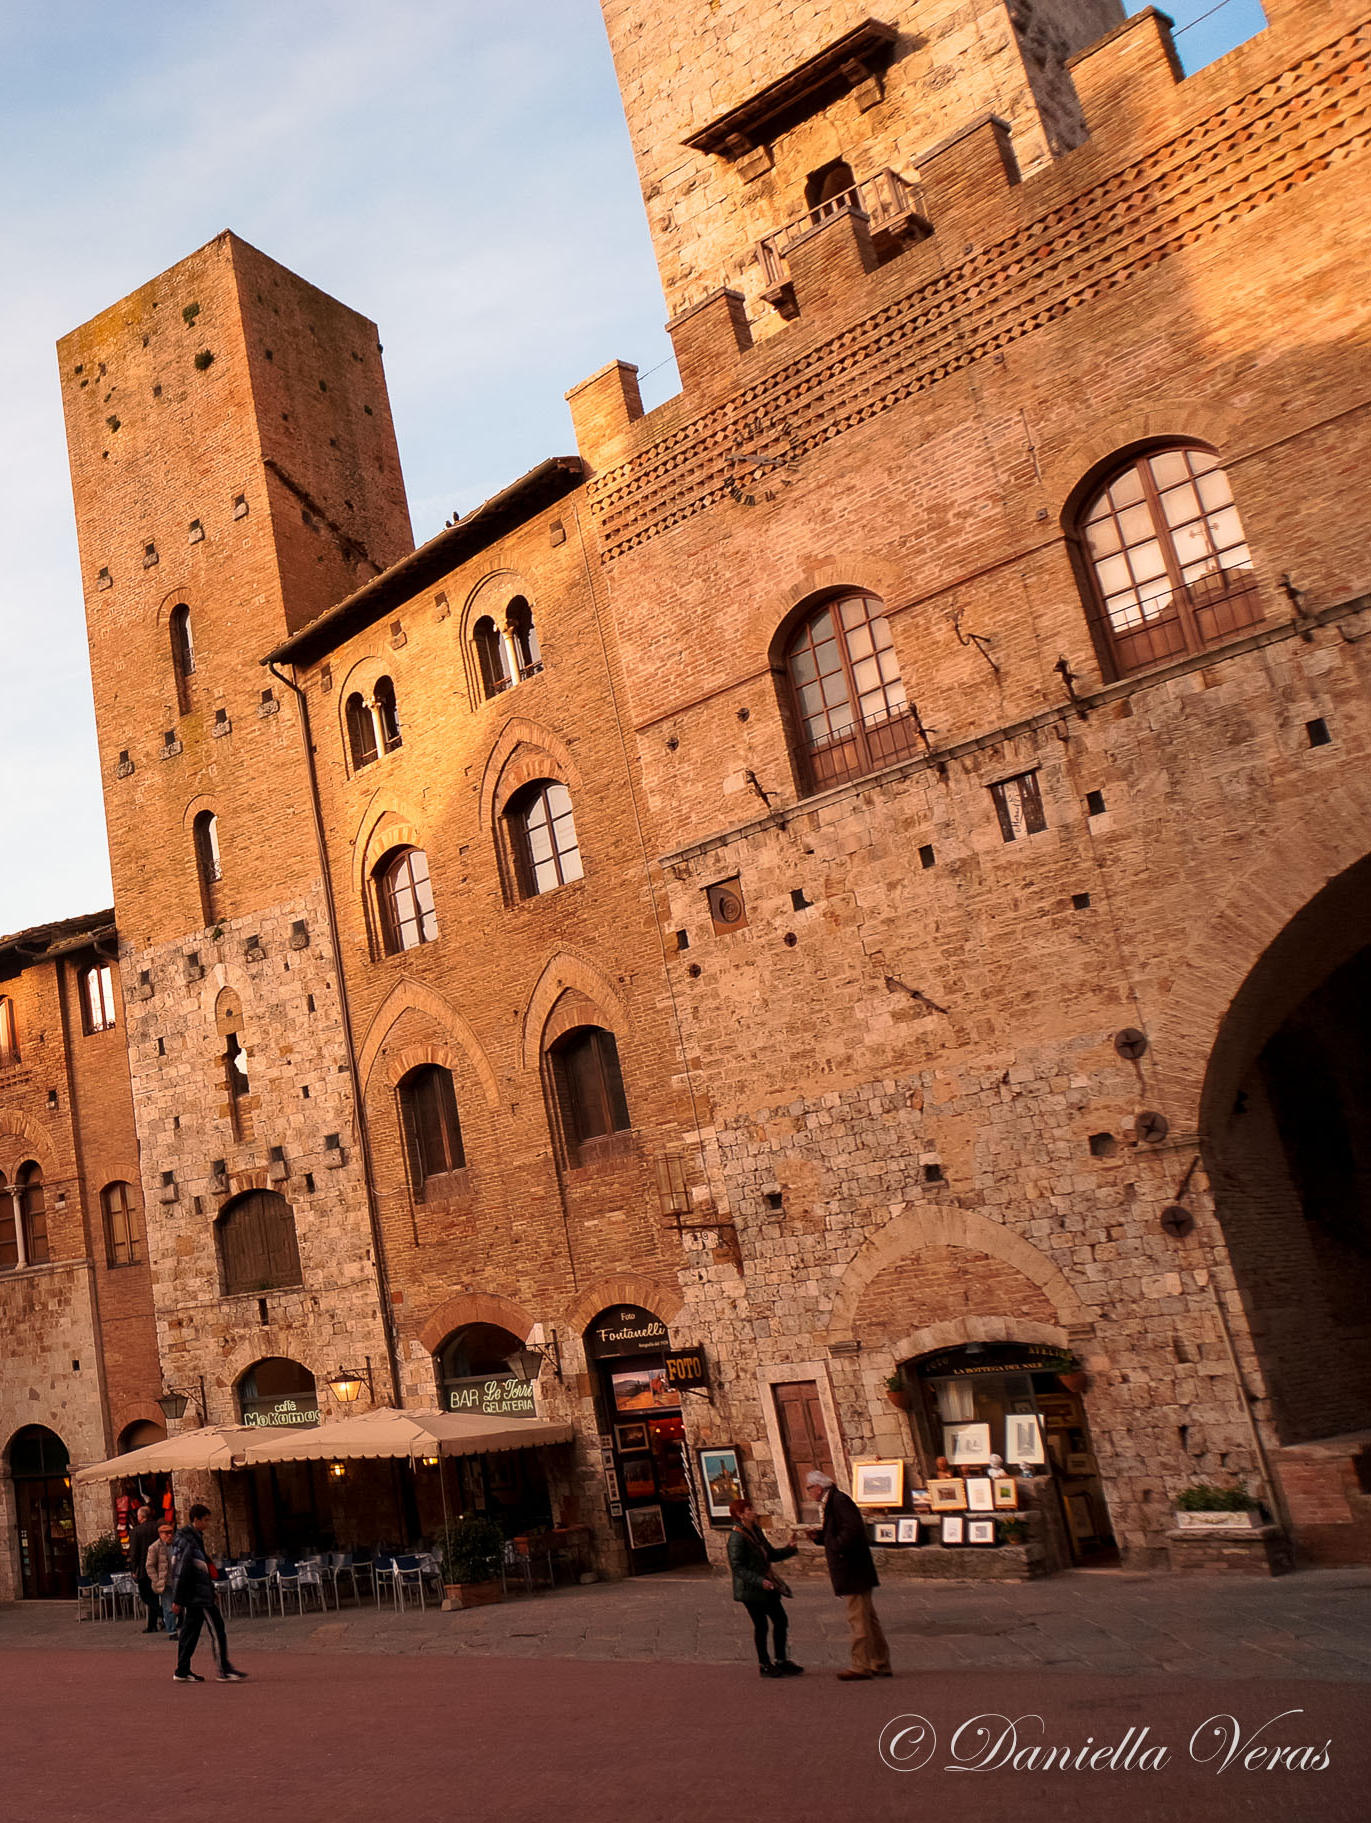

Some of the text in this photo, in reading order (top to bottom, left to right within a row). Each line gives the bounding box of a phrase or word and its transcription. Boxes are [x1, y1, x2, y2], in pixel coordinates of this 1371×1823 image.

[620, 1312, 636, 1321] Foto
[596, 1322, 666, 1342] Fontanelli
[666, 1356, 702, 1381] FOTO
[965, 1366, 1004, 1374] BOTTEGA
[450, 1379, 533, 1408] BAR Le Torri
[274, 1399, 297, 1412] caffè
[482, 1399, 534, 1414] GELATERIA
